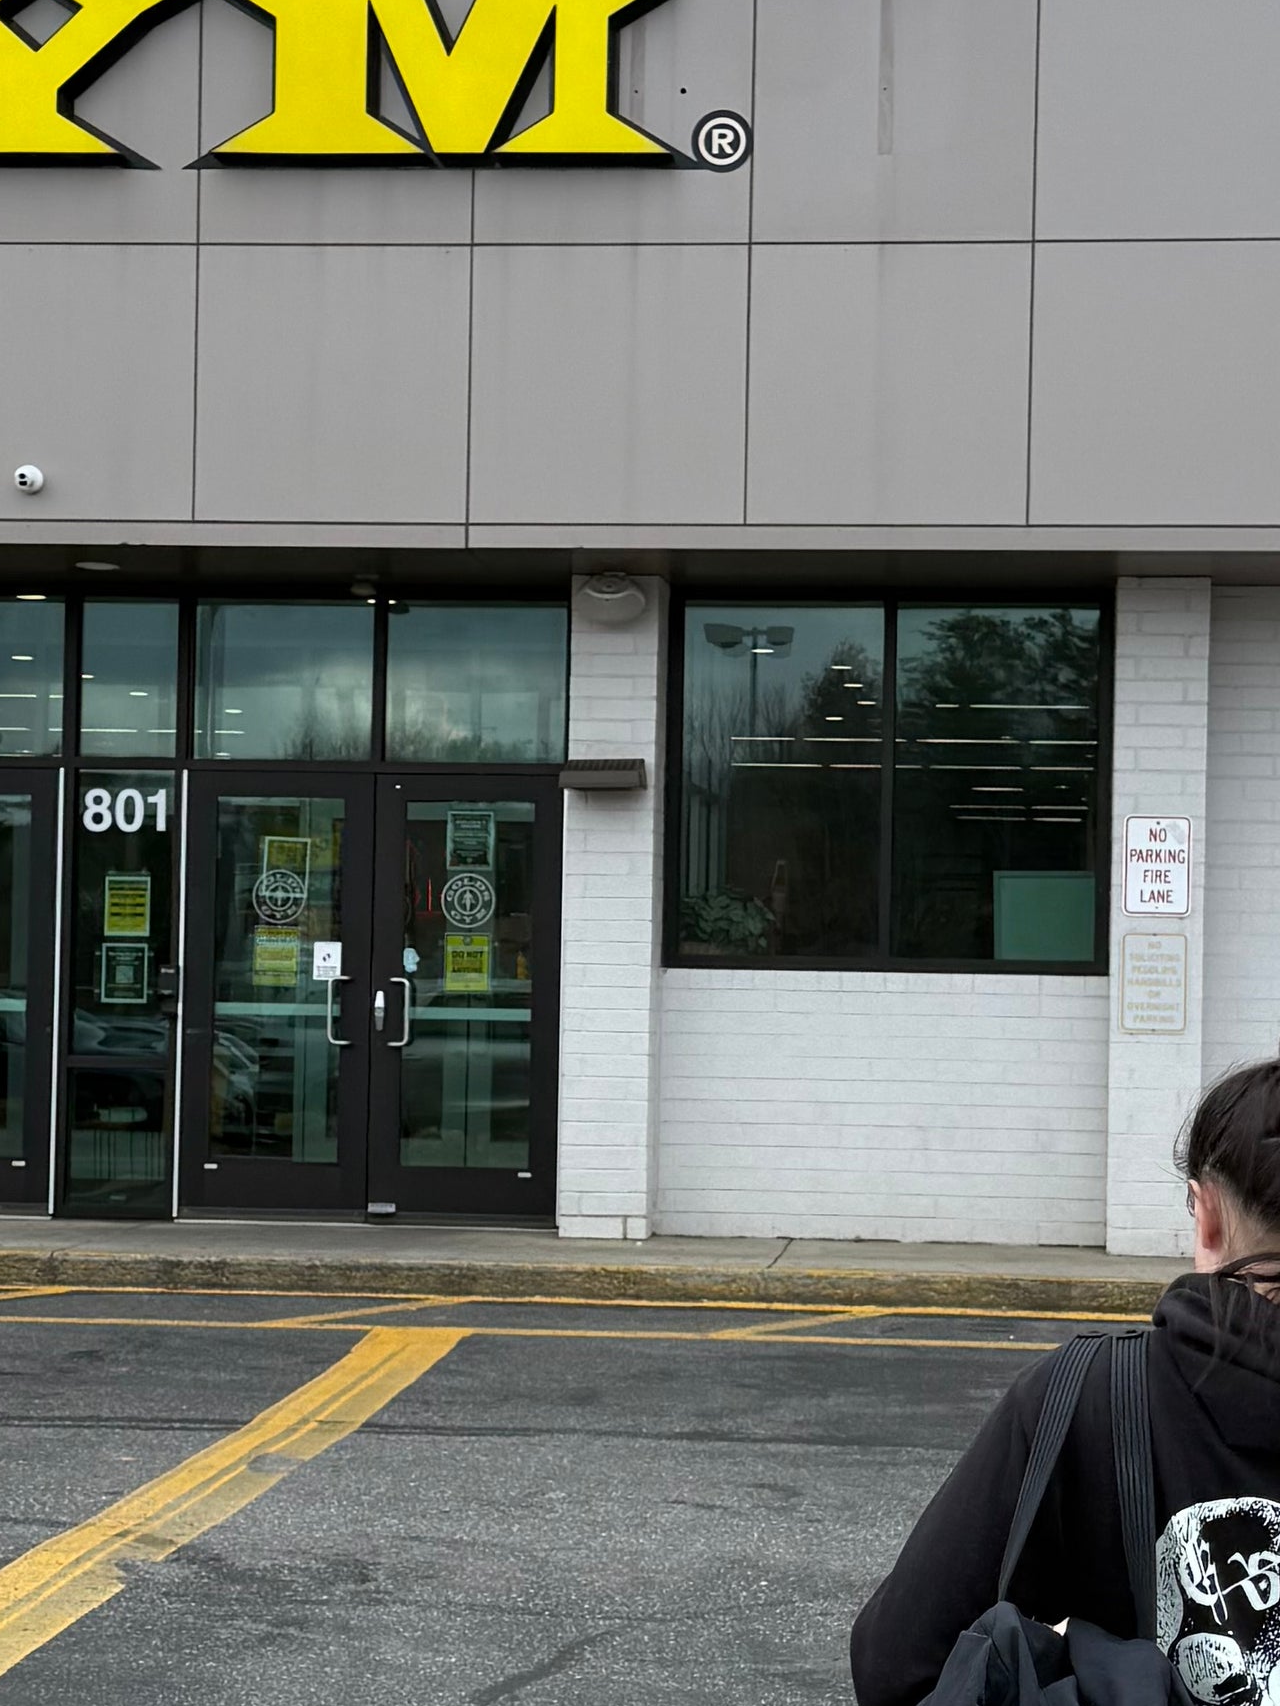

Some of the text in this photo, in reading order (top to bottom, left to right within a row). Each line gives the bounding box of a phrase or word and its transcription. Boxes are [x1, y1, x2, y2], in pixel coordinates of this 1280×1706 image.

[82, 788, 167, 833] 801
[1149, 827, 1167, 843] NO
[1130, 849, 1186, 864] PARKING
[1143, 869, 1172, 884] FIRE
[1140, 889, 1174, 904] LANE
